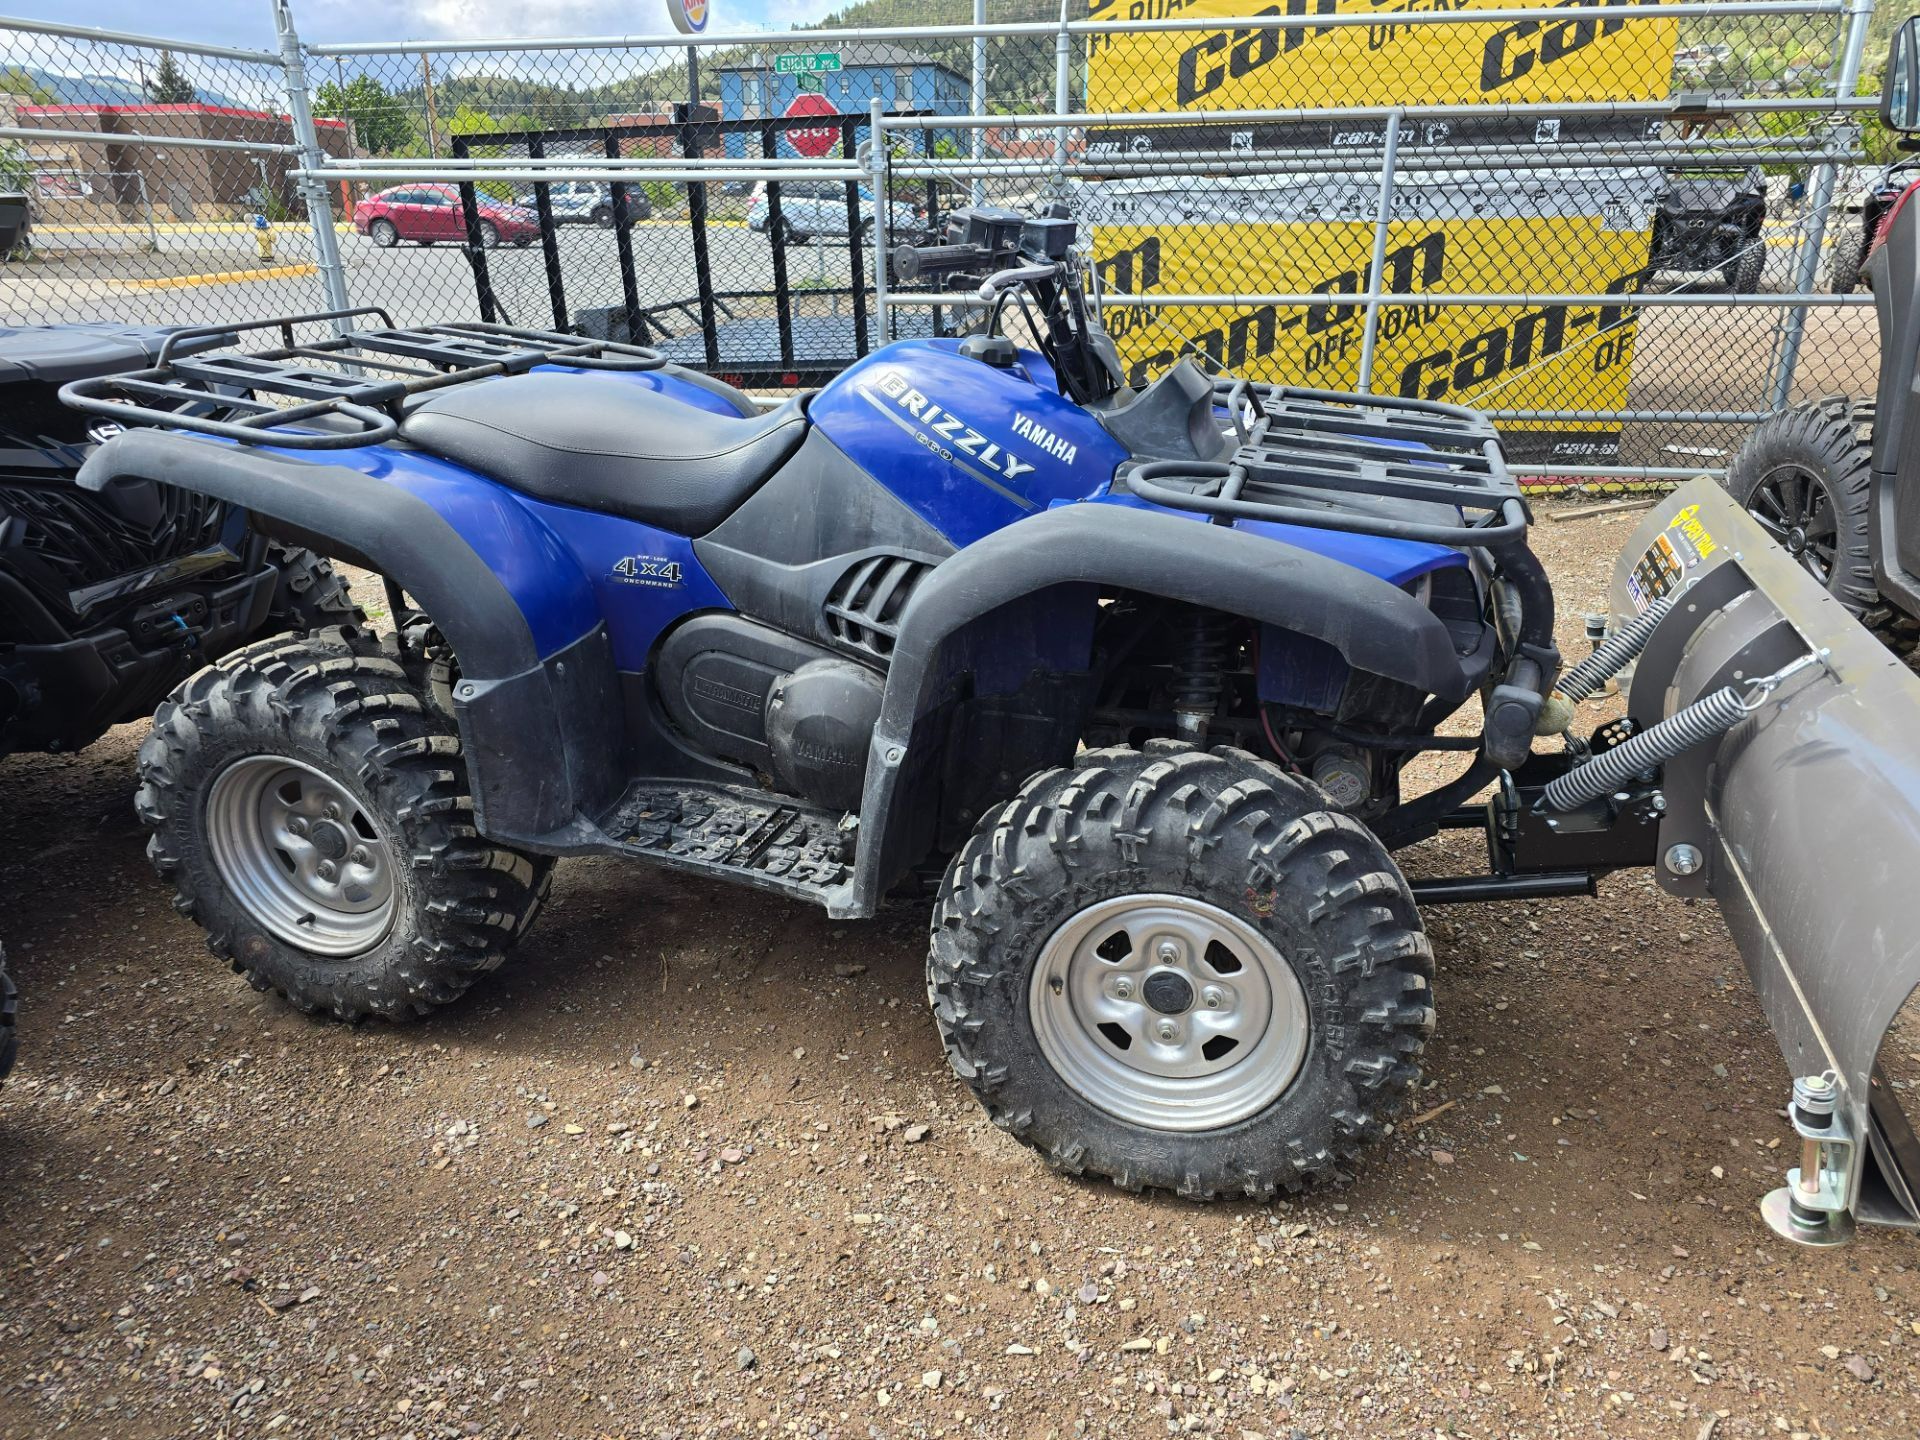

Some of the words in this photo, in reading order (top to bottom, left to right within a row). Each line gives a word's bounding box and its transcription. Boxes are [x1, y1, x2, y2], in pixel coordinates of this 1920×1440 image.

[781, 57, 816, 70] EUCLID
[821, 59, 835, 68] AVE
[876, 371, 1036, 480] GRIZZLY
[1010, 412, 1078, 466] YAMAHA
[915, 431, 953, 463] 660
[623, 577, 673, 589] ONCOMMAND
